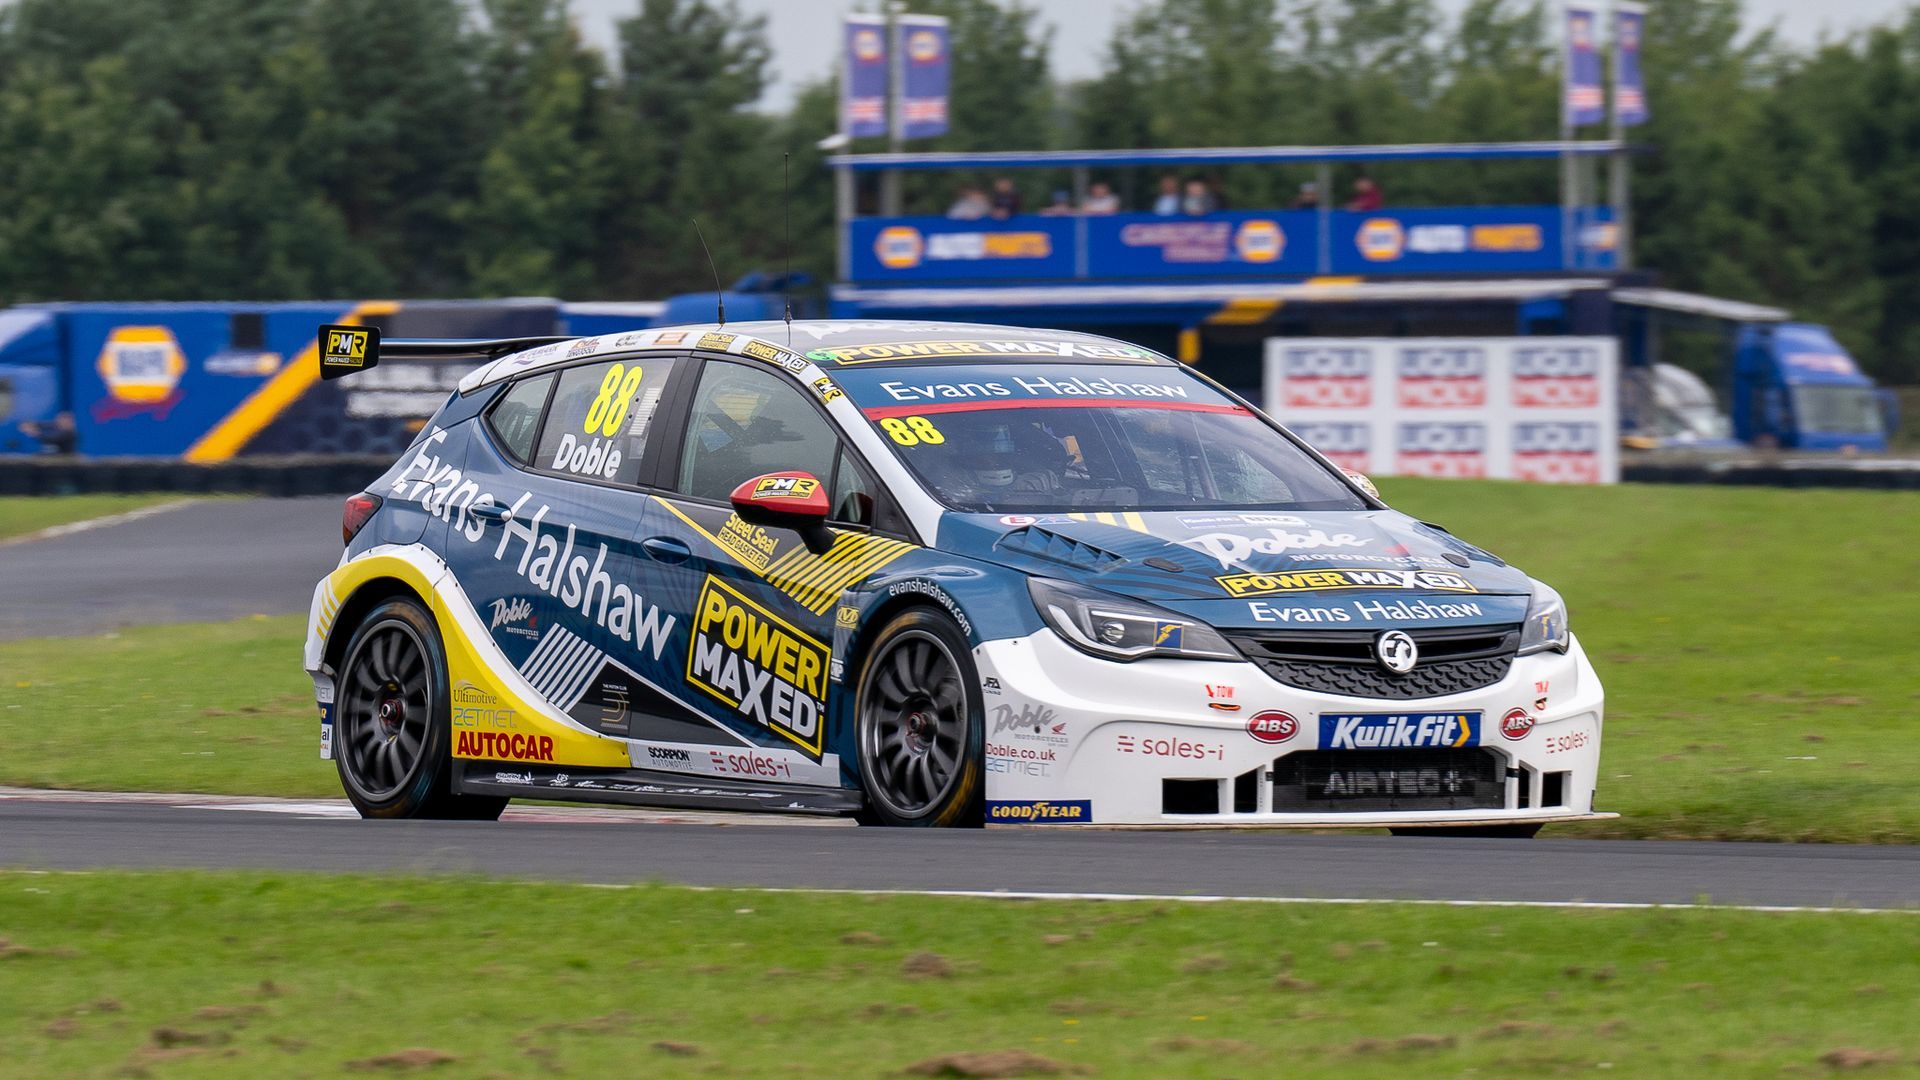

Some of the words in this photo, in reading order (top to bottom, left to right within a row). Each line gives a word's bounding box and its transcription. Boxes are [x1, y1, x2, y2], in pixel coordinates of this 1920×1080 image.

[329, 334, 364, 354] PMR
[745, 342, 777, 358] POWER
[774, 350, 807, 370] MAXED
[834, 341, 981, 360] POWER
[985, 341, 1140, 359] MAXED
[584, 363, 643, 437] 88
[815, 377, 842, 401] PMR
[880, 380, 1012, 401] Evans
[1012, 375, 1189, 399] Halshaw
[880, 416, 946, 447] 88
[552, 433, 622, 478] Doble
[757, 478, 814, 491] PMR
[391, 426, 495, 543] Evans
[494, 491, 676, 661] Halshaw
[726, 512, 756, 541] Steel
[751, 528, 779, 556] Seal
[734, 537, 758, 562] GASKET
[1233, 571, 1351, 593] POWER
[1350, 570, 1469, 590] MAXED
[488, 597, 534, 632] Doble
[889, 578, 972, 637] evanshalshaw.com
[1248, 601, 1351, 622] Evans
[1353, 599, 1483, 620] Halshaw
[700, 588, 820, 698] POWER
[453, 689, 497, 705] Ultimotive
[693, 632, 819, 738] MAXED
[988, 703, 1059, 738] Doble
[1254, 719, 1293, 734] ABS
[1504, 716, 1535, 731] ABS
[457, 731, 553, 761] AUTOCAR
[1014, 733, 1069, 743] MOTORCYCLES
[1142, 737, 1223, 760] sales-i
[1558, 729, 1590, 752] sales-i
[648, 747, 691, 762] SCORPION
[985, 743, 1056, 761] Doble.co.uk
[652, 759, 693, 770] AUTOMOTIVE
[729, 751, 791, 778] sales-i
[1324, 769, 1439, 794] AIRTEC
[992, 801, 1082, 821] GOODYEAR
